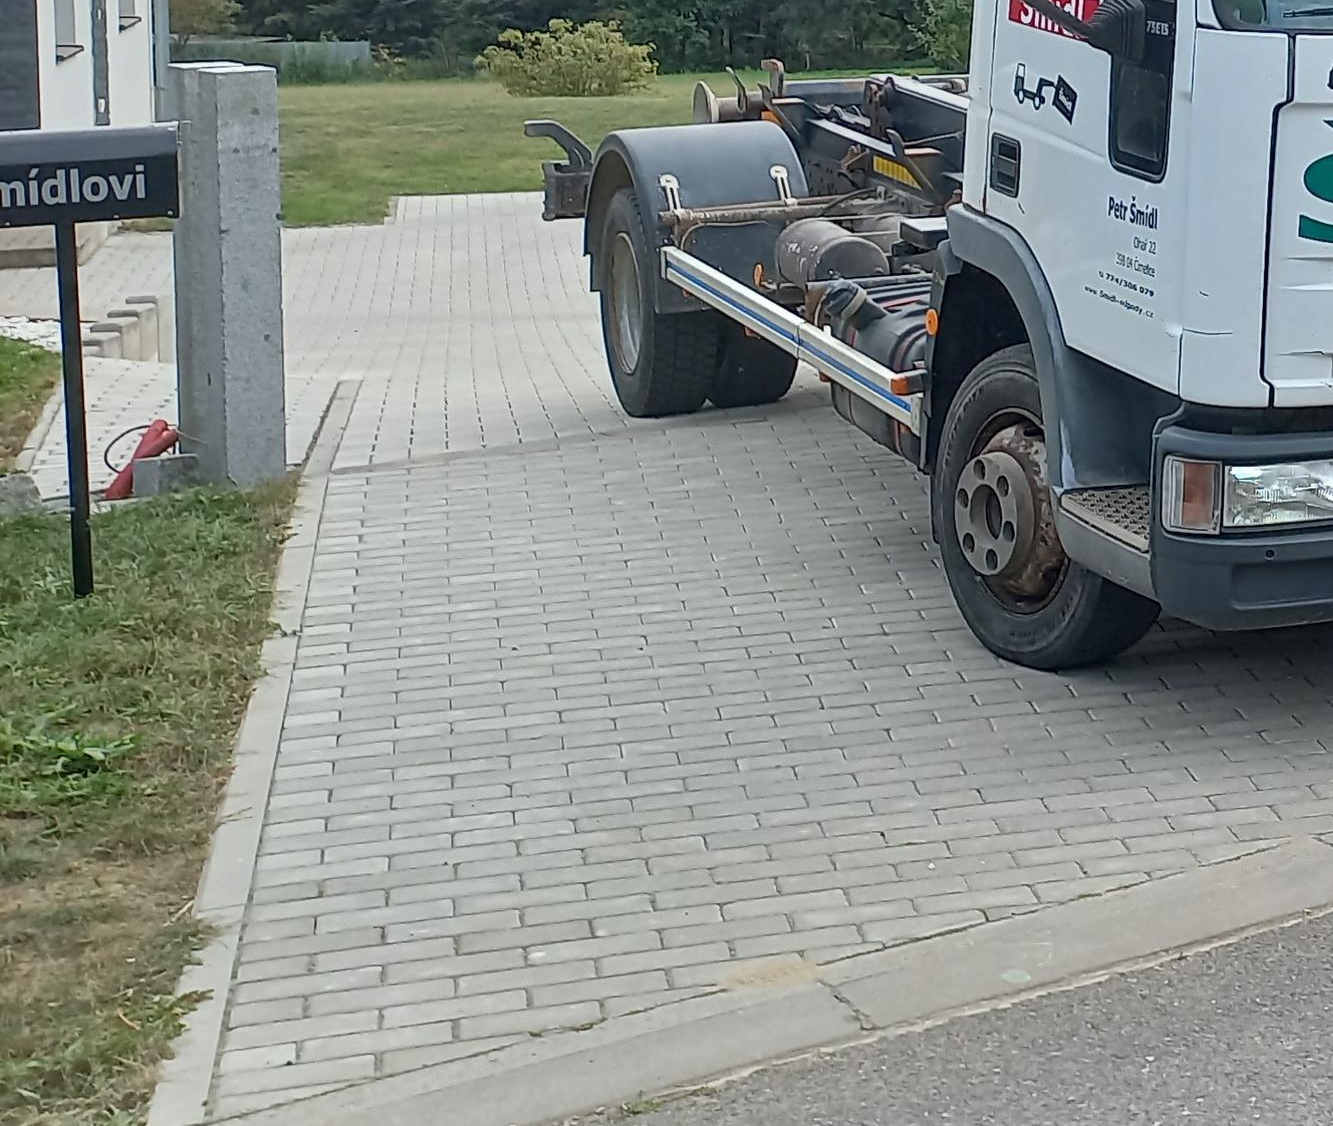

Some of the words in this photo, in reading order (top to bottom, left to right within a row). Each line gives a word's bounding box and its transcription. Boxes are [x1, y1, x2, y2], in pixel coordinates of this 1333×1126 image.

[1107, 195, 1128, 222] Petr
[1129, 194, 1158, 230] Šmídl
[1138, 285, 1155, 298] 079
